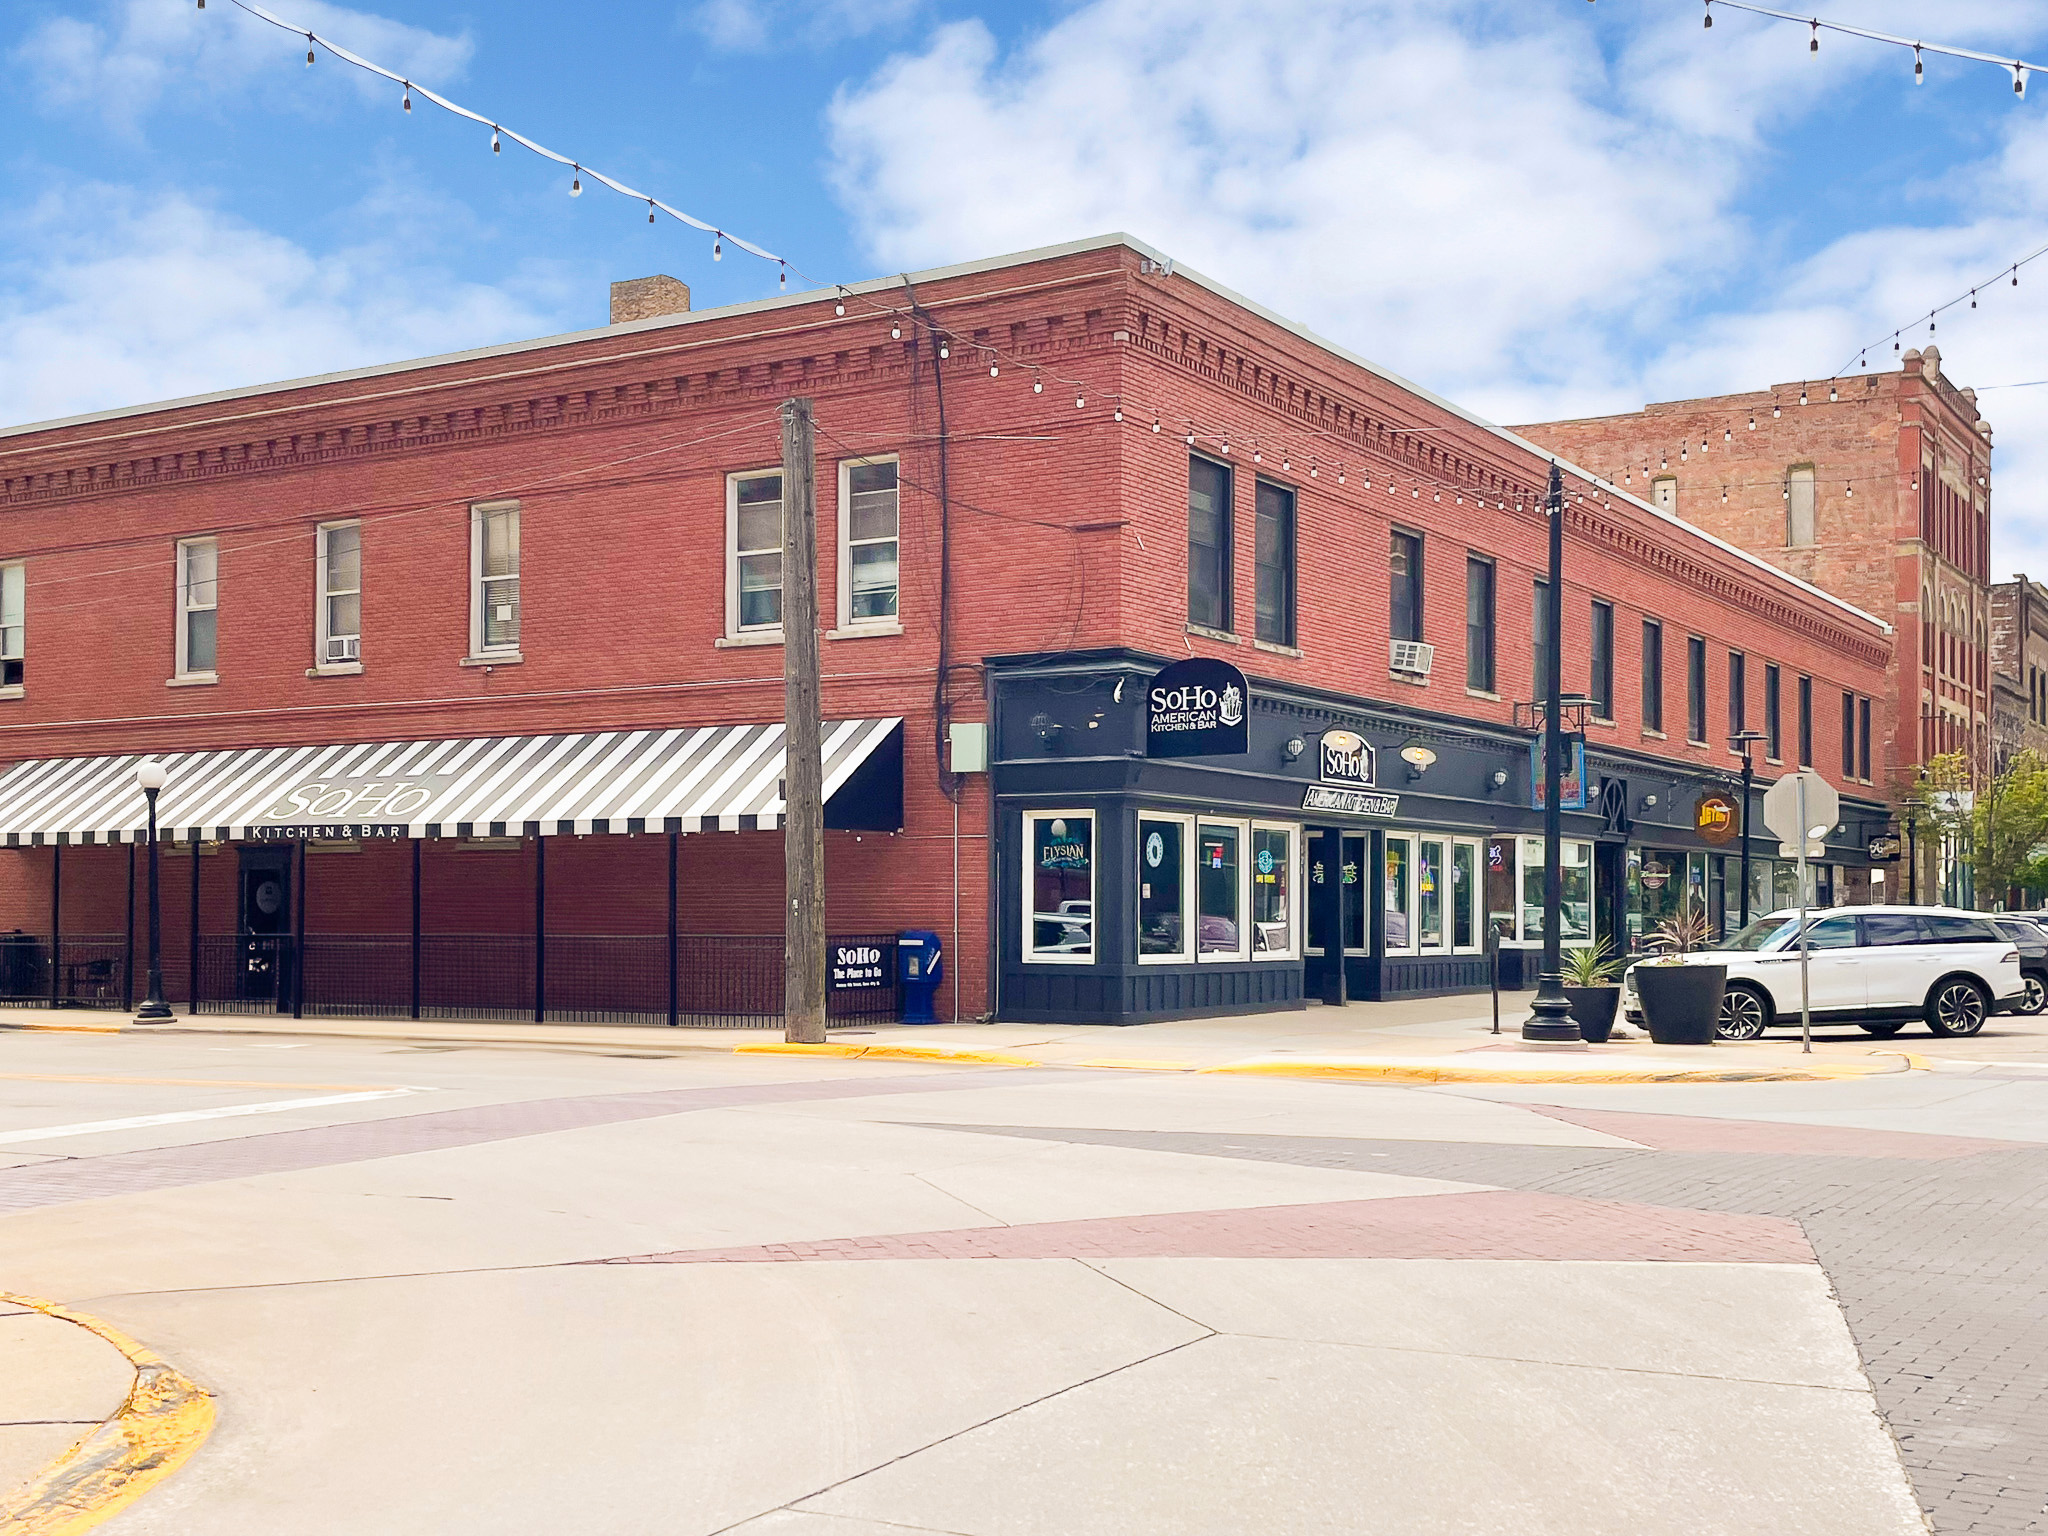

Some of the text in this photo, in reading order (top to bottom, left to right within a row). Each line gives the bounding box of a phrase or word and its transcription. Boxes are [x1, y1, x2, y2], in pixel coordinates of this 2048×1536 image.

[1151, 685, 1217, 713] SoHo
[1151, 709, 1217, 724] AMERICAN
[1151, 720, 1217, 733] KITCHEN & BAR
[1326, 748, 1360, 777] SoHo
[262, 781, 432, 820] SoHo
[1306, 789, 1348, 810] AMERICAN
[1379, 797, 1397, 814] BAR
[252, 824, 400, 839] KITCHEN & BAR
[1043, 844, 1084, 862] ELYSIAN
[837, 947, 881, 965] SoHo
[833, 968, 845, 979] The
